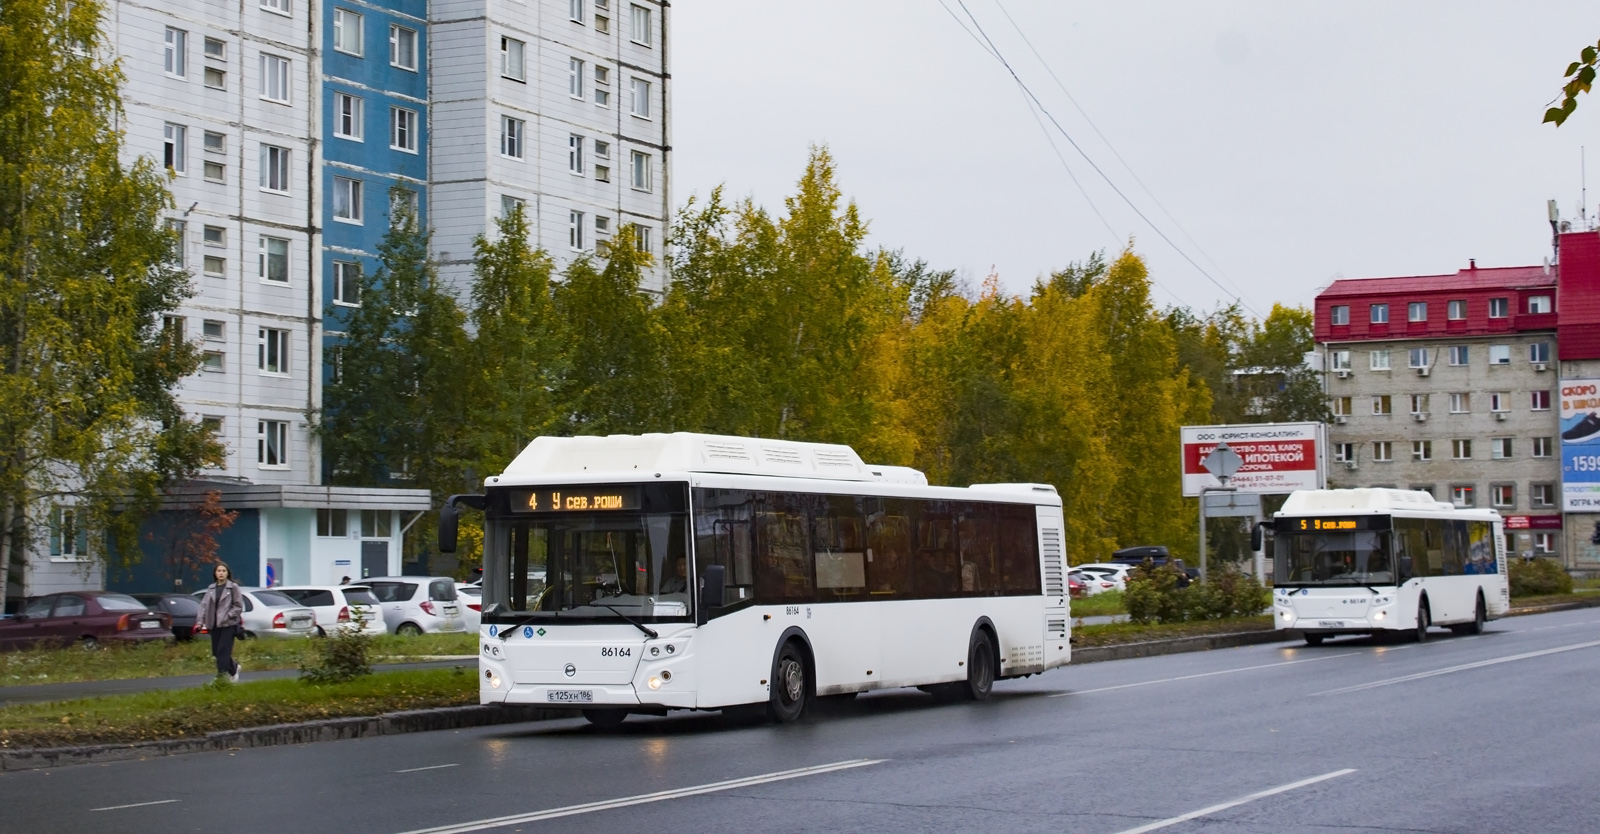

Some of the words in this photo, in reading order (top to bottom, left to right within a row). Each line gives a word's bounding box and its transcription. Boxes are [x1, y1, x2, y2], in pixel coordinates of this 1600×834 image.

[1562, 385, 1596, 396] СКОРО
[1278, 443, 1303, 452] КЛЮЧ
[1246, 451, 1303, 462] ИПОТЕКОЙ
[529, 492, 537, 510] 4
[1300, 519, 1307, 530] 5
[786, 606, 799, 615] 86164
[601, 647, 631, 657] 86164
